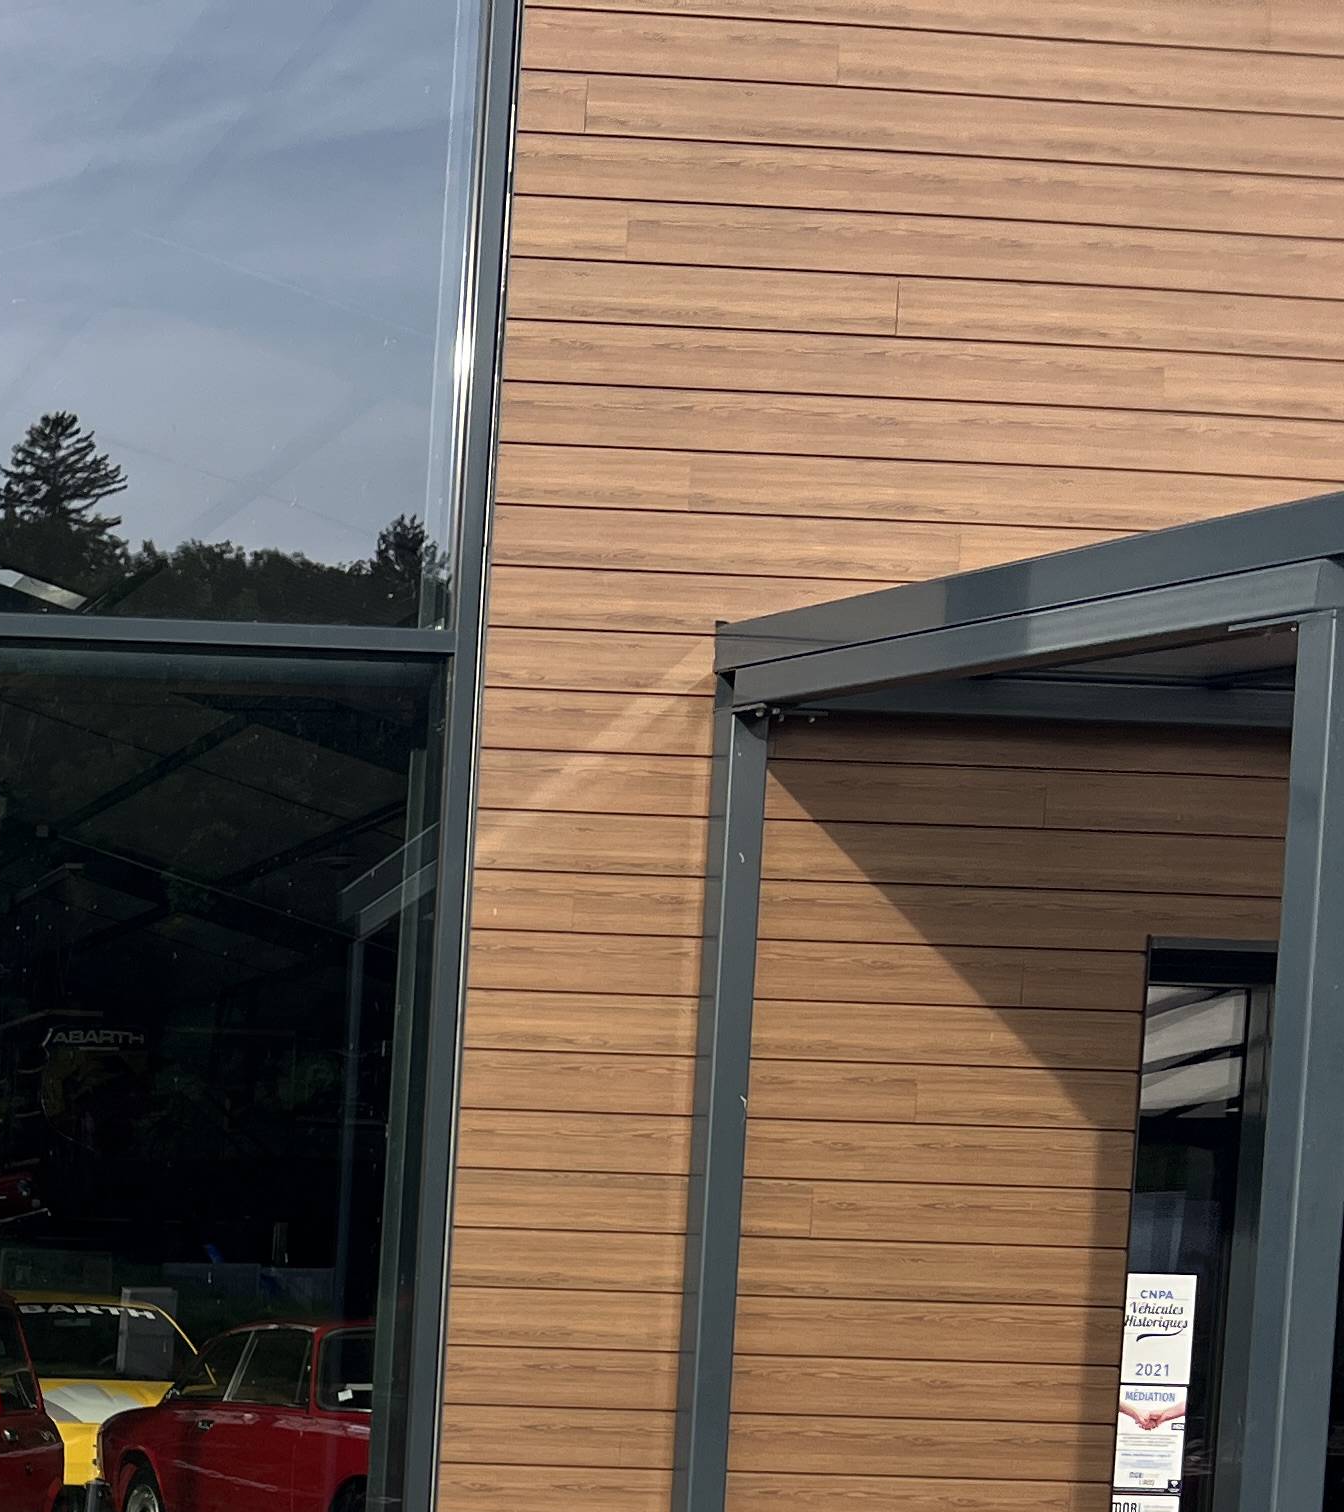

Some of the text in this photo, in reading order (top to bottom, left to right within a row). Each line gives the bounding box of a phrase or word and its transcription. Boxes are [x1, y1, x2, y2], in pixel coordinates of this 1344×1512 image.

[52, 1029, 145, 1045] ABARTH
[1140, 1289, 1175, 1300] CNPA
[18, 1303, 156, 1320] BARTH
[1129, 1301, 1184, 1315] Véhicules
[1124, 1314, 1189, 1331] Historiques
[1135, 1363, 1170, 1377] 2021
[1124, 1388, 1176, 1402] MÉDIATION
